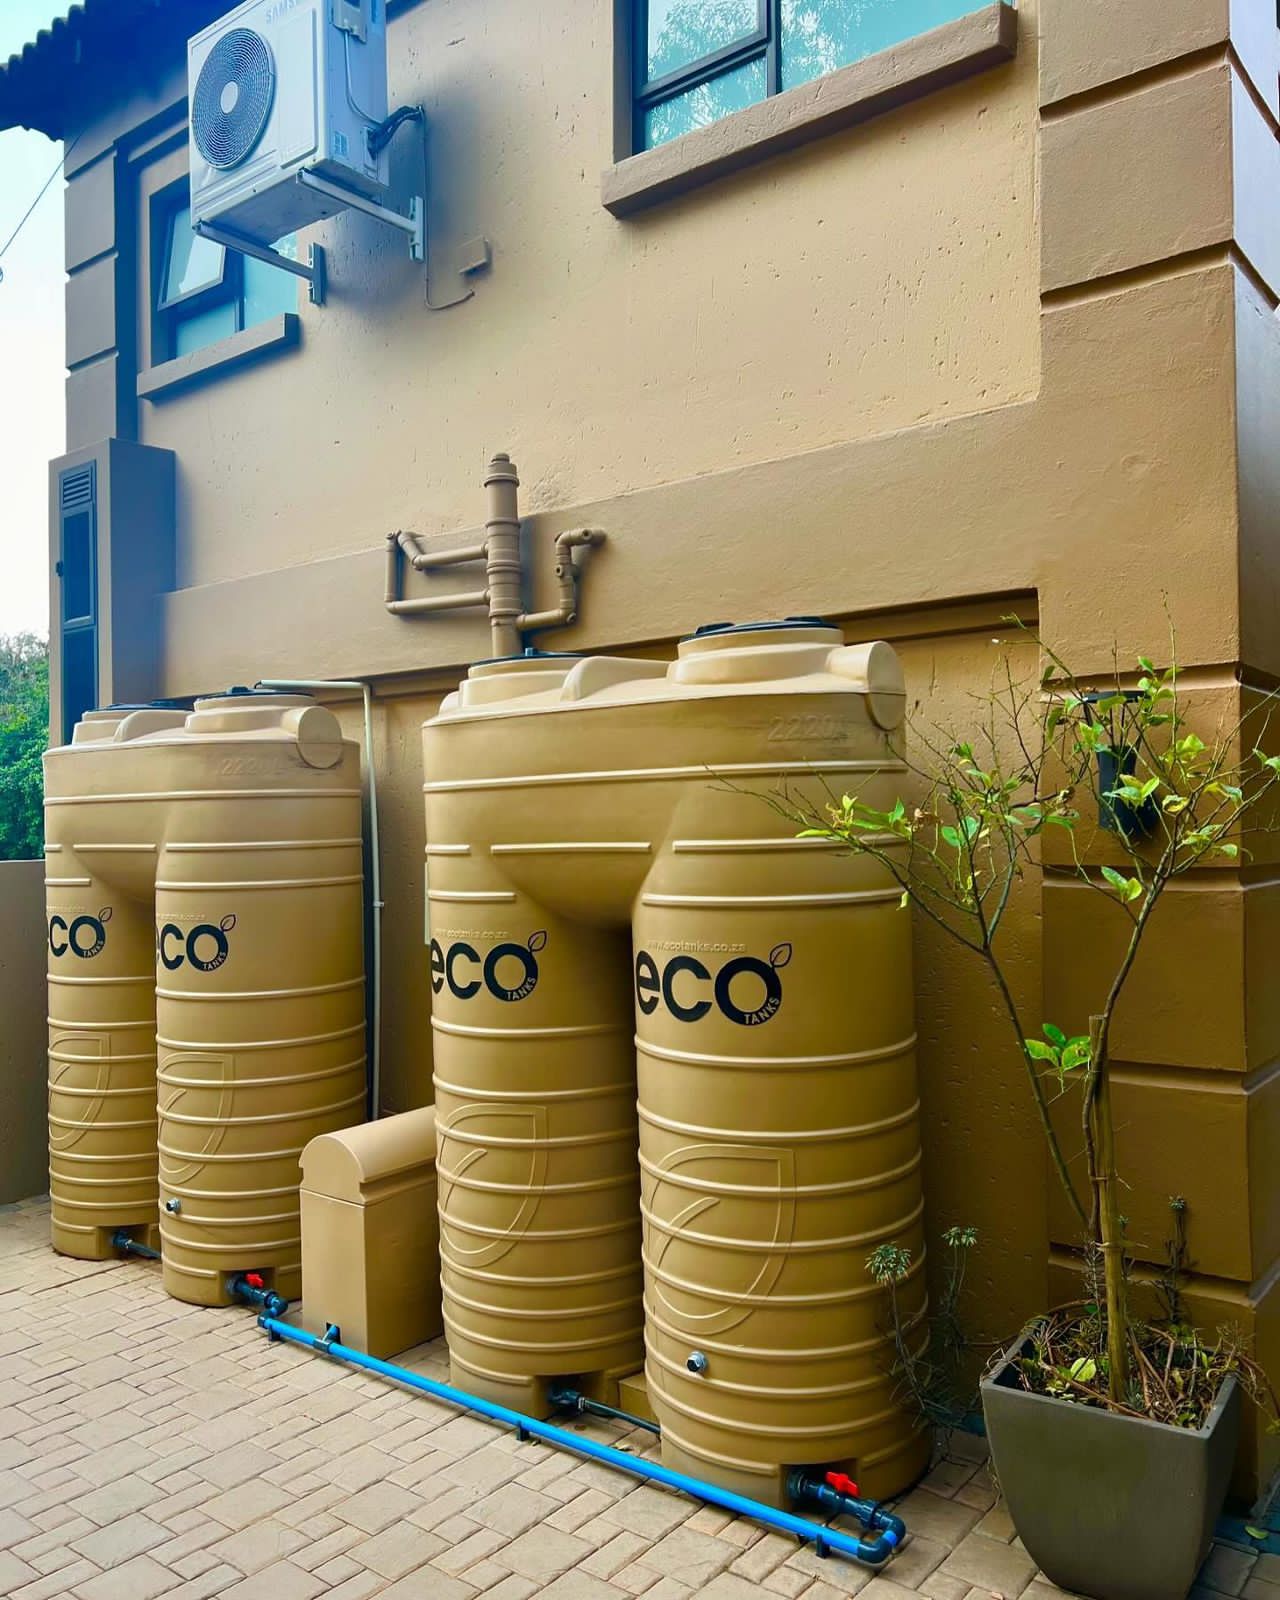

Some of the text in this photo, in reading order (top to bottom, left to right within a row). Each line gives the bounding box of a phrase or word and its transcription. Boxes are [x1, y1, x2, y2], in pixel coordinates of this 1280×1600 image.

[49, 915, 106, 957] co
[156, 923, 229, 971] co
[430, 938, 539, 1002] eco
[506, 977, 536, 1001] TANKS
[635, 950, 782, 1027] eco
[744, 997, 780, 1025] TANKS
